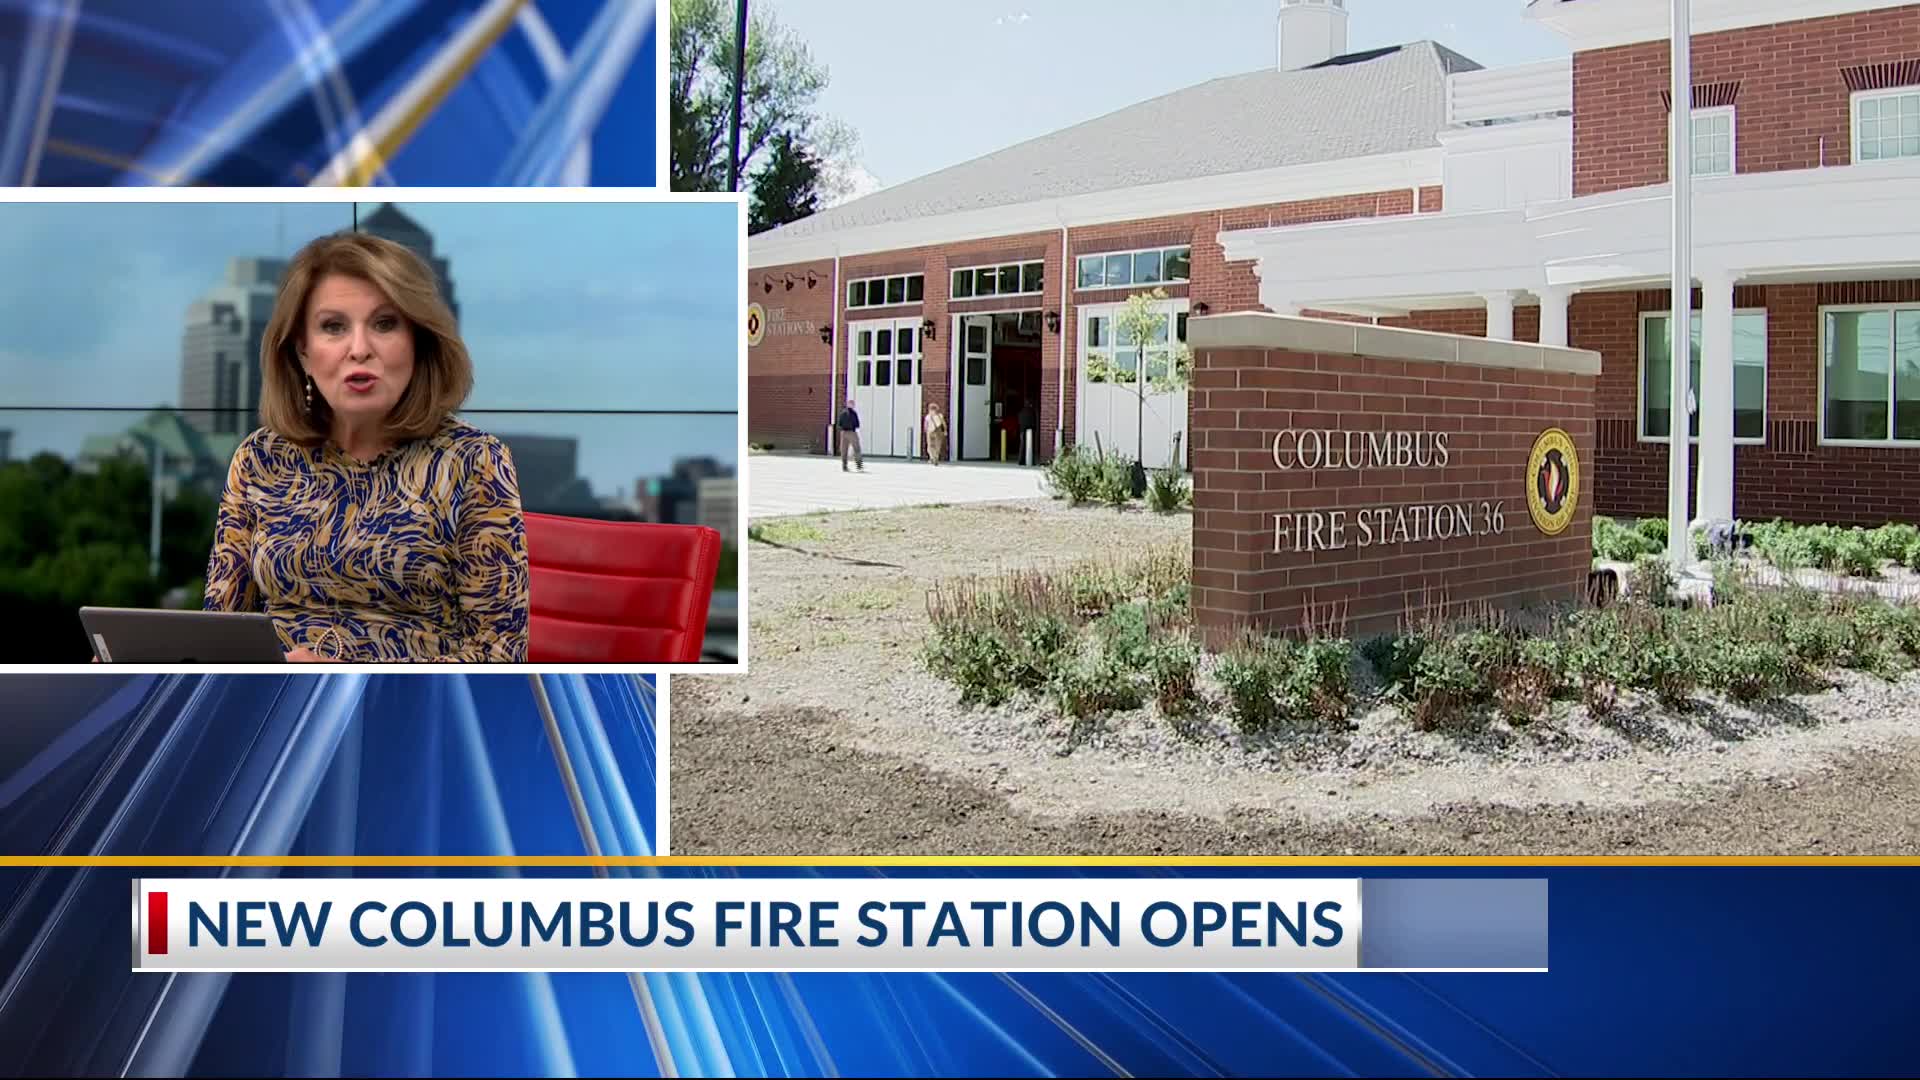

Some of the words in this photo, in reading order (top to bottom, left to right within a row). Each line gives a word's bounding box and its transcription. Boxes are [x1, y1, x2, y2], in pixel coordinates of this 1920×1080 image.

[767, 307, 785, 321] FIRE
[767, 320, 804, 336] STATION
[1272, 428, 1450, 470] COLUMBUS
[1272, 510, 1348, 553] FIRE
[1356, 502, 1473, 548] STATION
[1480, 501, 1505, 535] 36
